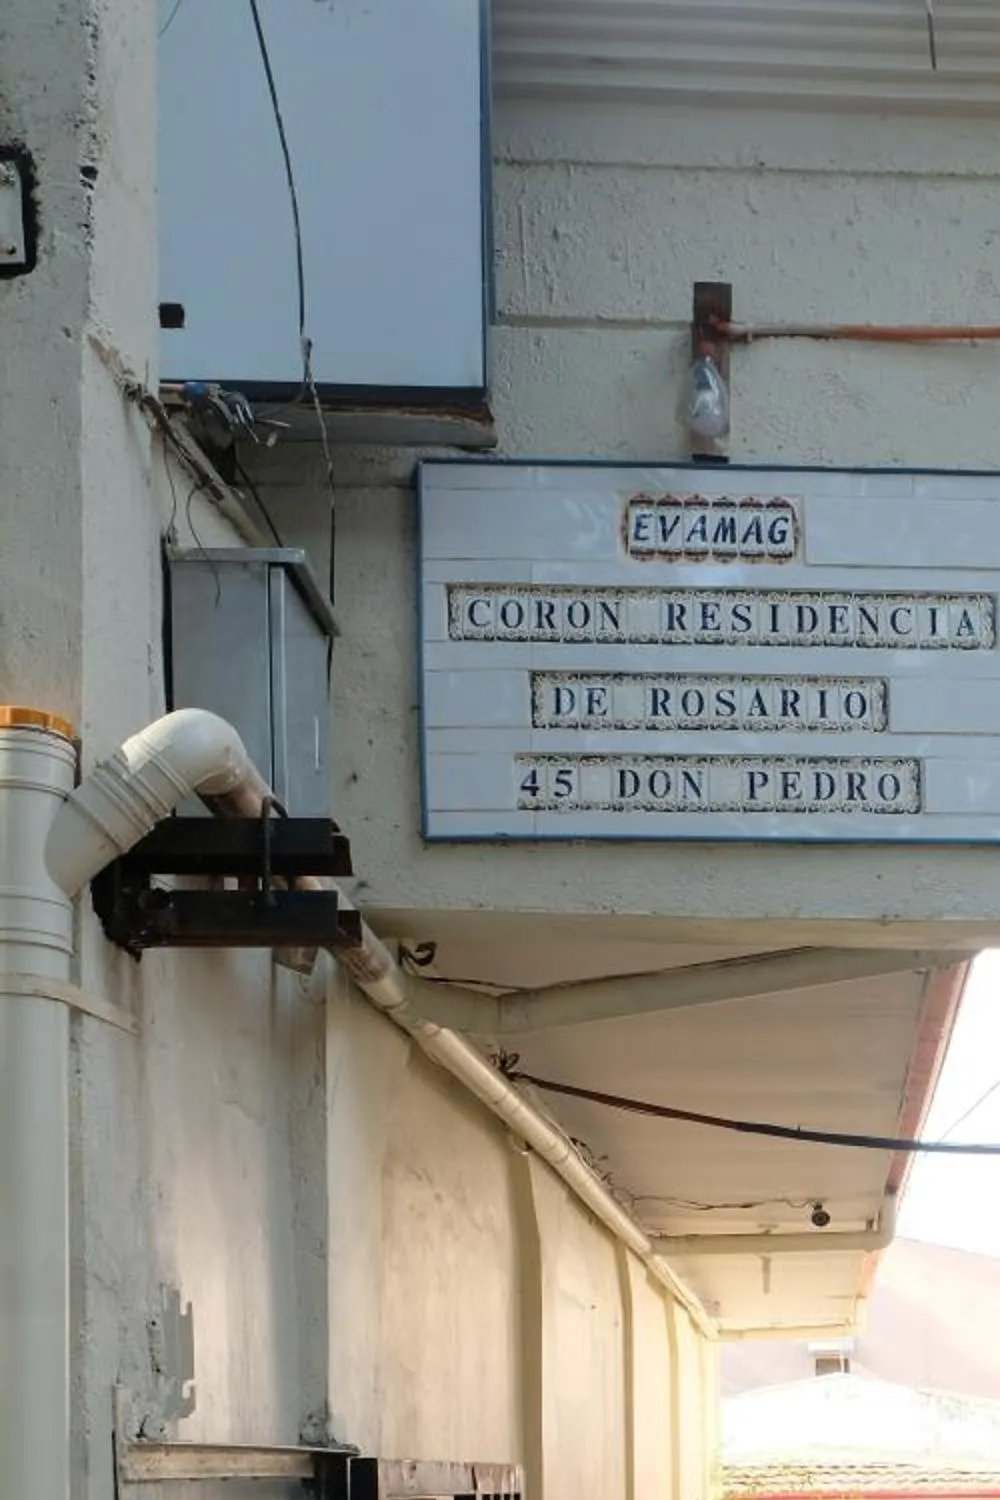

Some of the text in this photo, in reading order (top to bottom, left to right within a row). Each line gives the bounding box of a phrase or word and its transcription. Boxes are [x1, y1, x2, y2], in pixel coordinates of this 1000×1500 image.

[633, 514, 789, 546] EVAMAG
[467, 599, 976, 637] CORON RESIDENCIA
[553, 686, 868, 719] DE ROSARIO
[520, 769, 901, 801] 45 DON PEDRO
